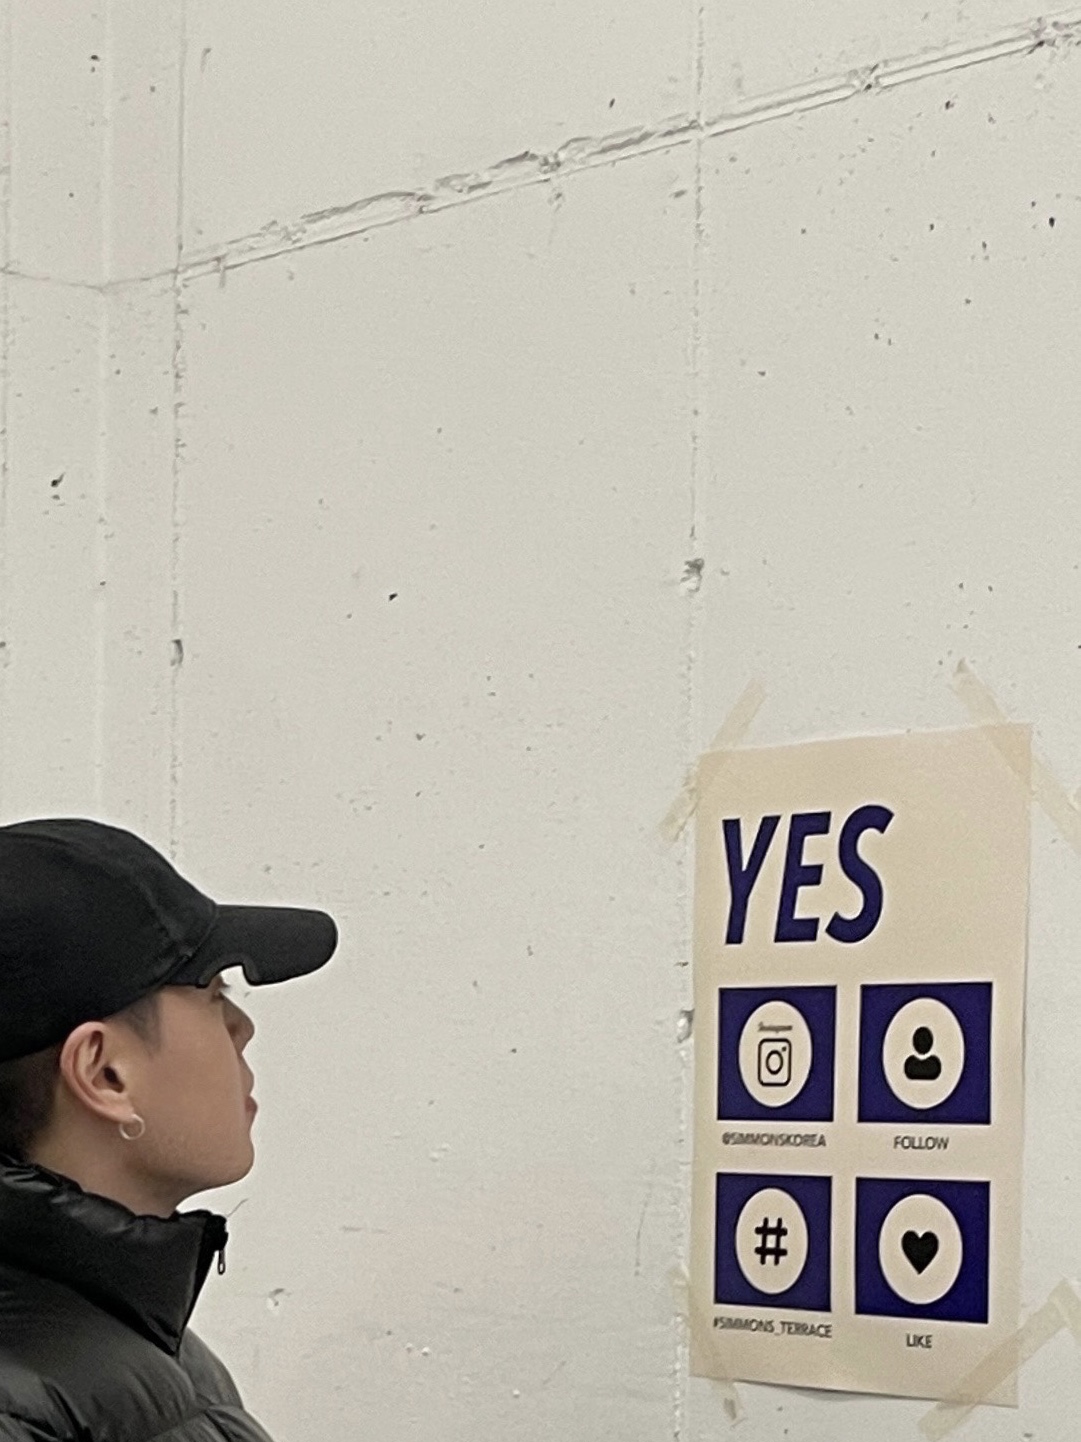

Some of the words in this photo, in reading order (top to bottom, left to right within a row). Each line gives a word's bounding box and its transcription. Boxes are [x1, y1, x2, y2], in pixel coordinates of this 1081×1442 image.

[721, 803, 895, 946] YES
[721, 1131, 827, 1148] @SIMMONSKOREA
[893, 1135, 950, 1150] FOLLOW
[713, 1316, 833, 1339] #SIMMONS_TERRACE
[905, 1333, 933, 1349] LIKE
